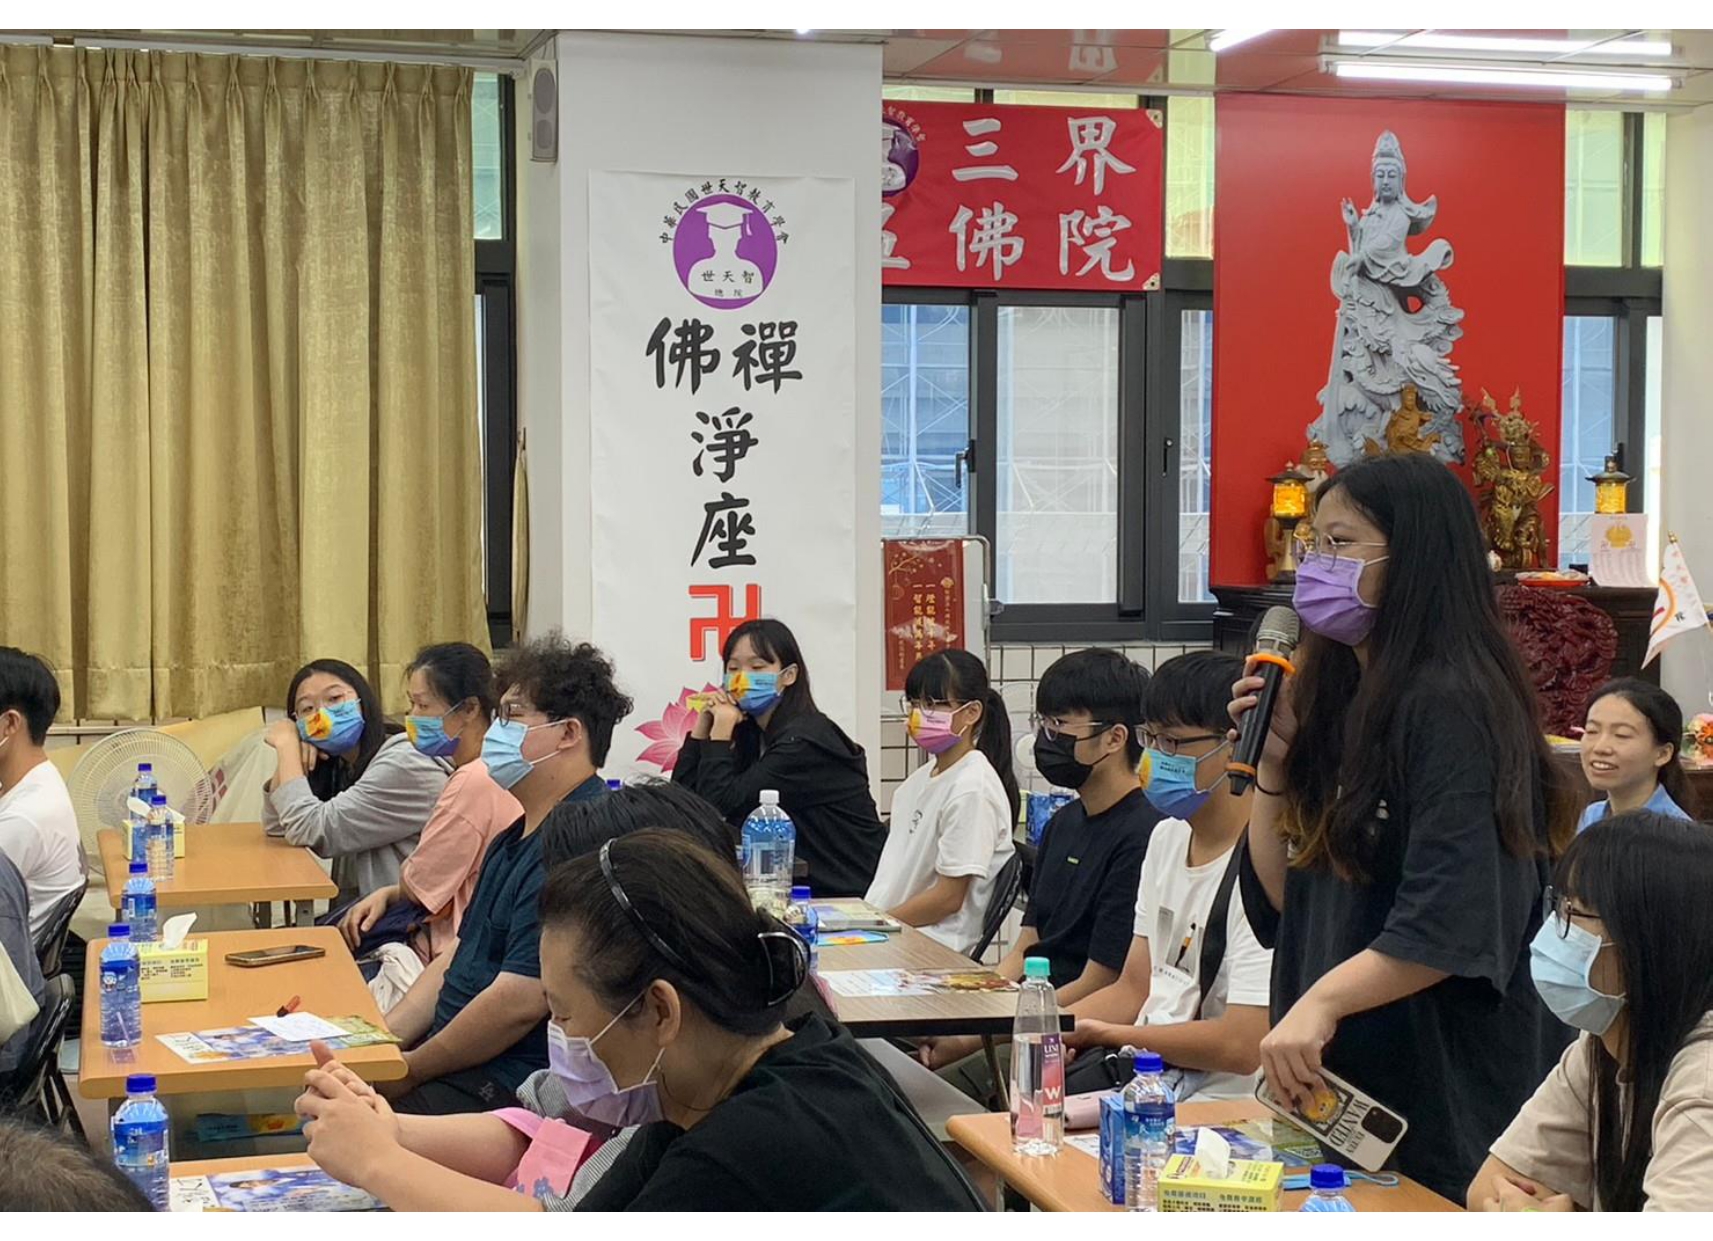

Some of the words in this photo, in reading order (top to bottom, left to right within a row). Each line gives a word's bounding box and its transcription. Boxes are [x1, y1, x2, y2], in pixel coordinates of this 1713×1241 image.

[952, 116, 1136, 195] 三界
[701, 270, 755, 284] 世天智
[645, 316, 803, 395] 佛禪
[1044, 1085, 1061, 1101] W
[1328, 1099, 1370, 1147] WANTED
